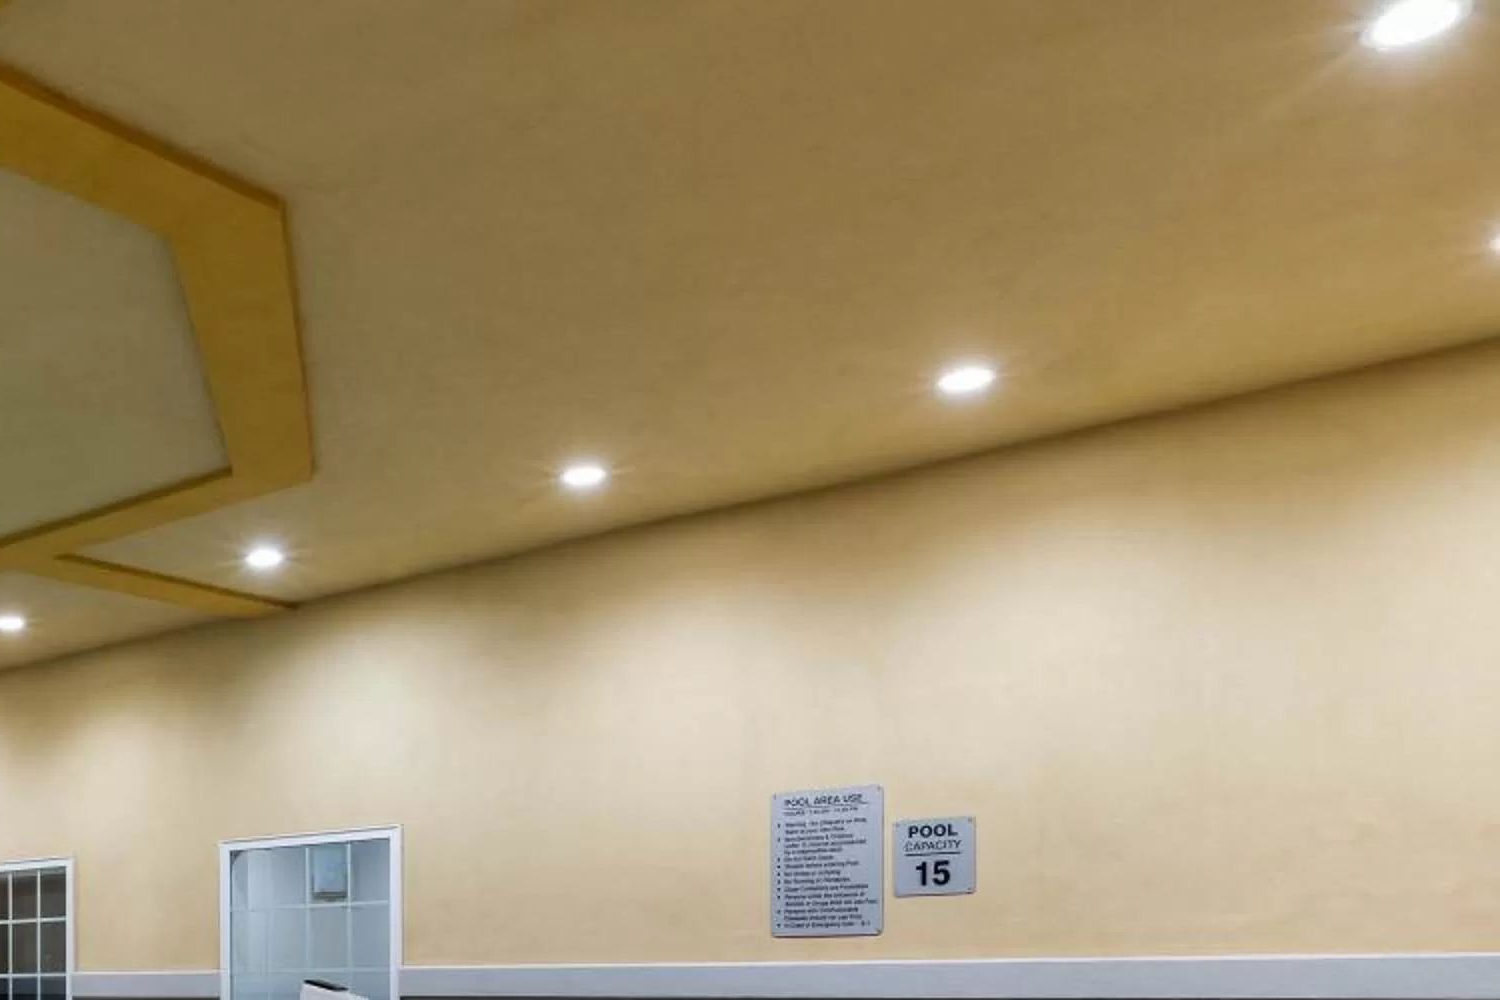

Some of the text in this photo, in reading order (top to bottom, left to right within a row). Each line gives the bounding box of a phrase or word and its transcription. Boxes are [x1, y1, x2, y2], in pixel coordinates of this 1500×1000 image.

[784, 793, 863, 807] POOL AREA USE
[908, 824, 959, 838] POOL
[904, 840, 962, 852] CAPACITY
[916, 860, 950, 887] 15
